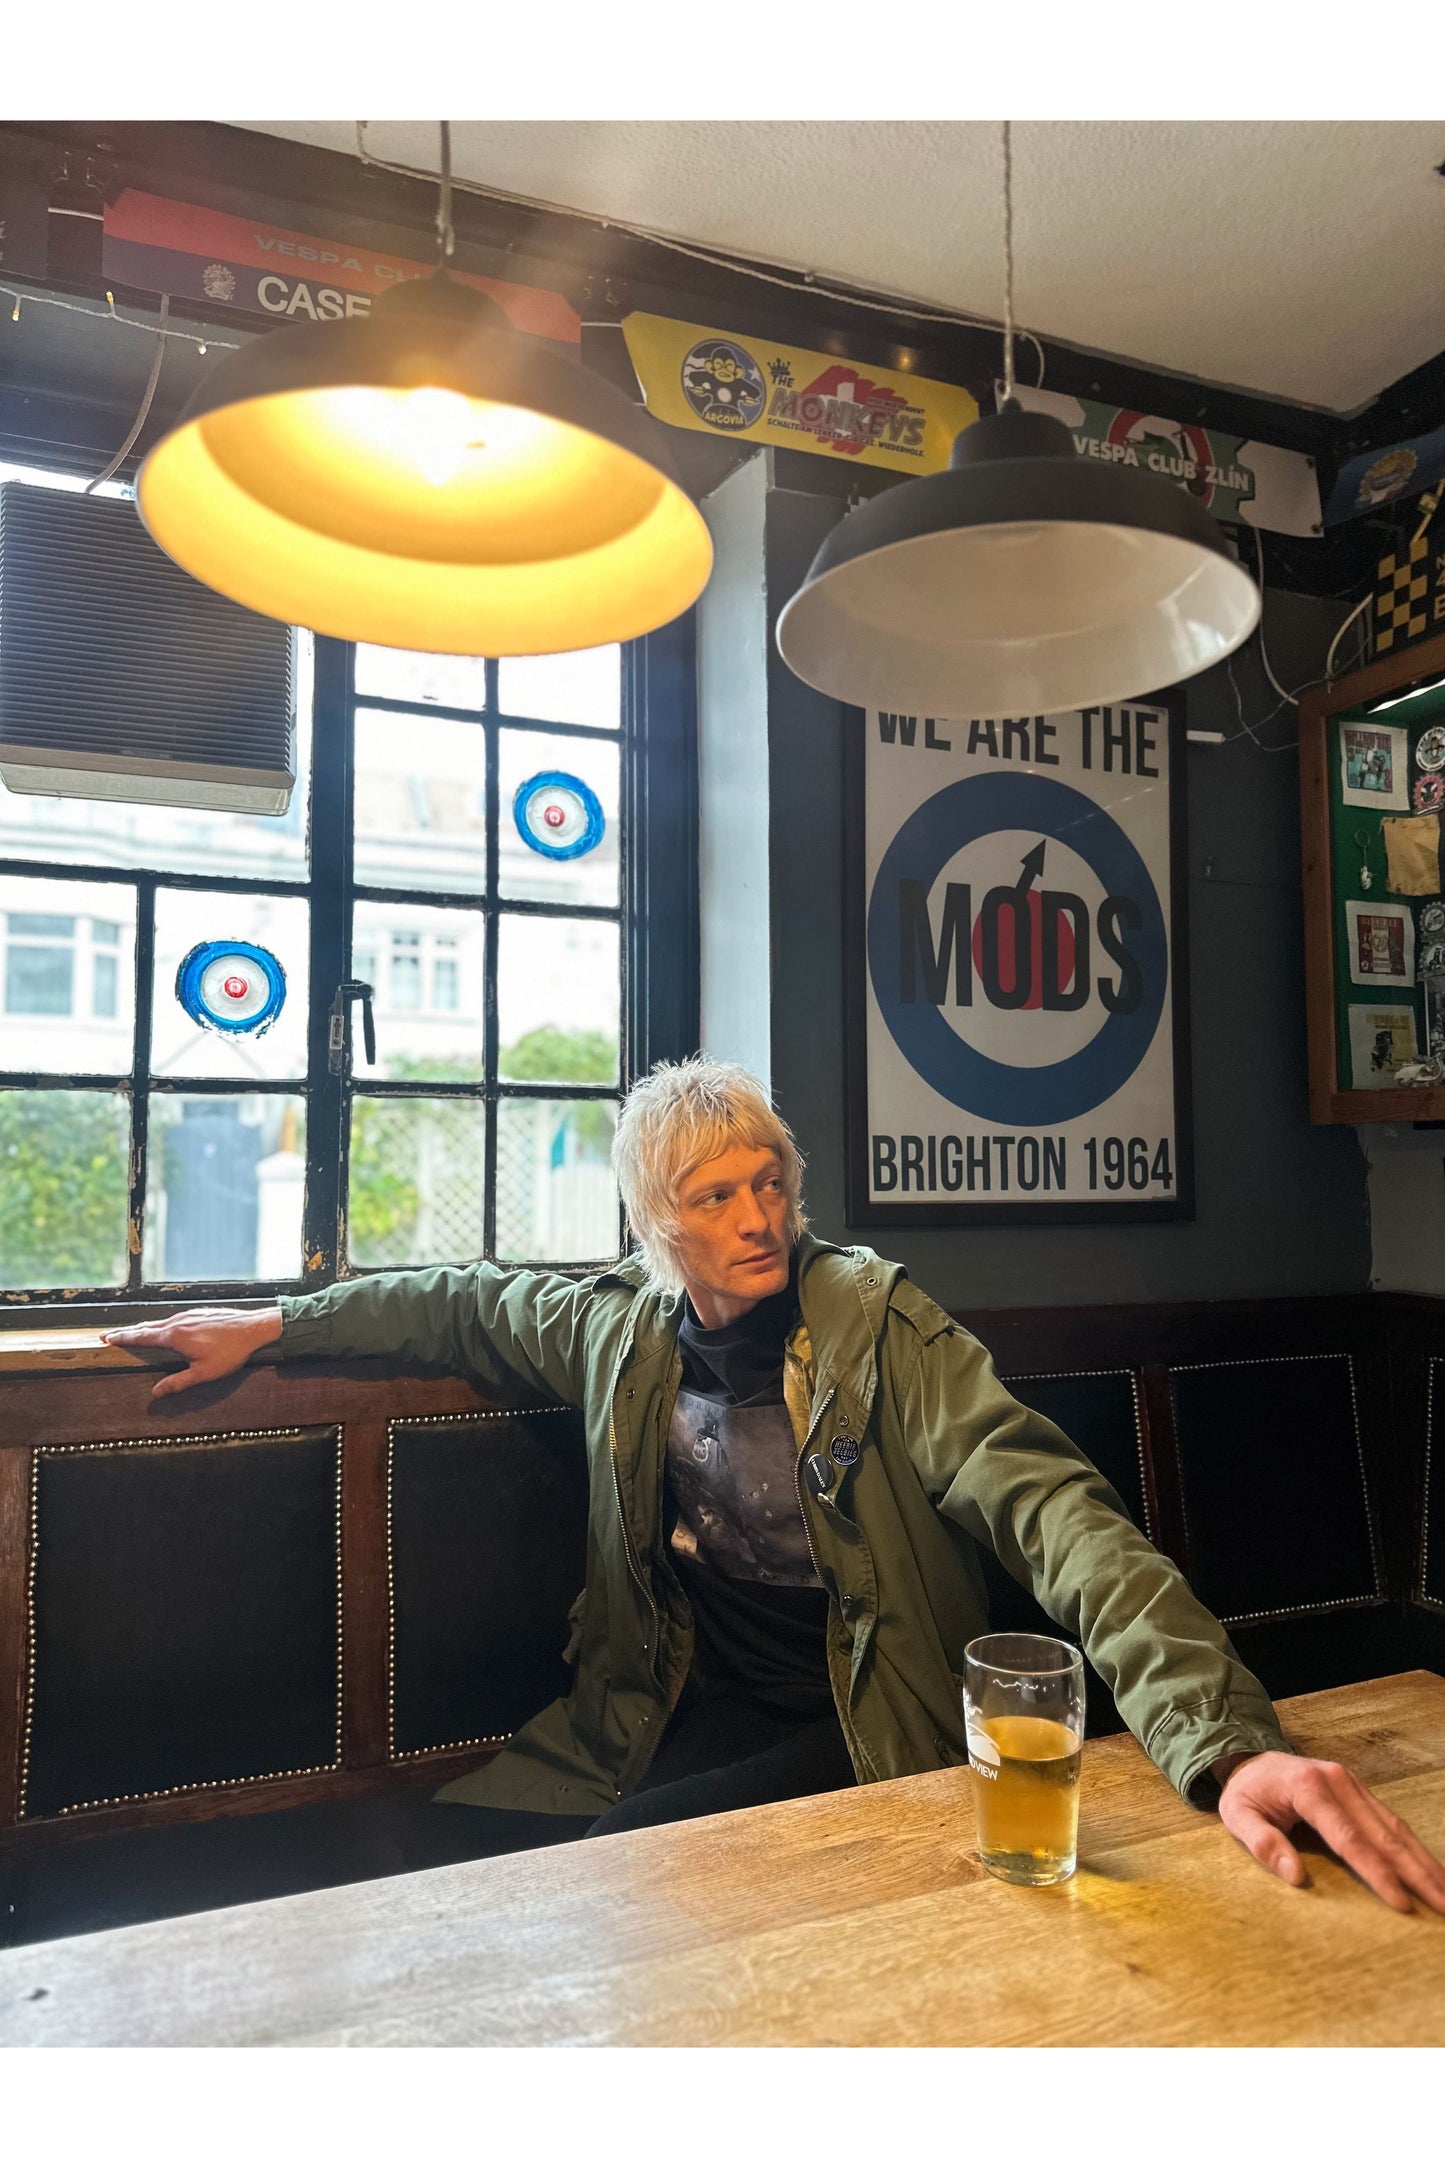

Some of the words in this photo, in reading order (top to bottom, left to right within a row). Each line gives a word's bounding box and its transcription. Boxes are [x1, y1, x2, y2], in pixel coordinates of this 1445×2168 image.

[254, 235, 363, 272] VESPA
[373, 264, 419, 282] CL
[771, 374, 794, 388] THE
[704, 412, 744, 425] ARGOVIA
[768, 389, 925, 445] MONKEYS
[1072, 434, 1139, 467] VESPA
[1148, 452, 1197, 480] CLUB
[1204, 463, 1250, 492] ZLÍN
[967, 714, 1059, 765] ARE
[1074, 706, 1159, 778] THE
[900, 879, 1144, 1016] MODS
[871, 1134, 1066, 1192] BRIGHTON
[1084, 1137, 1173, 1191] 1964
